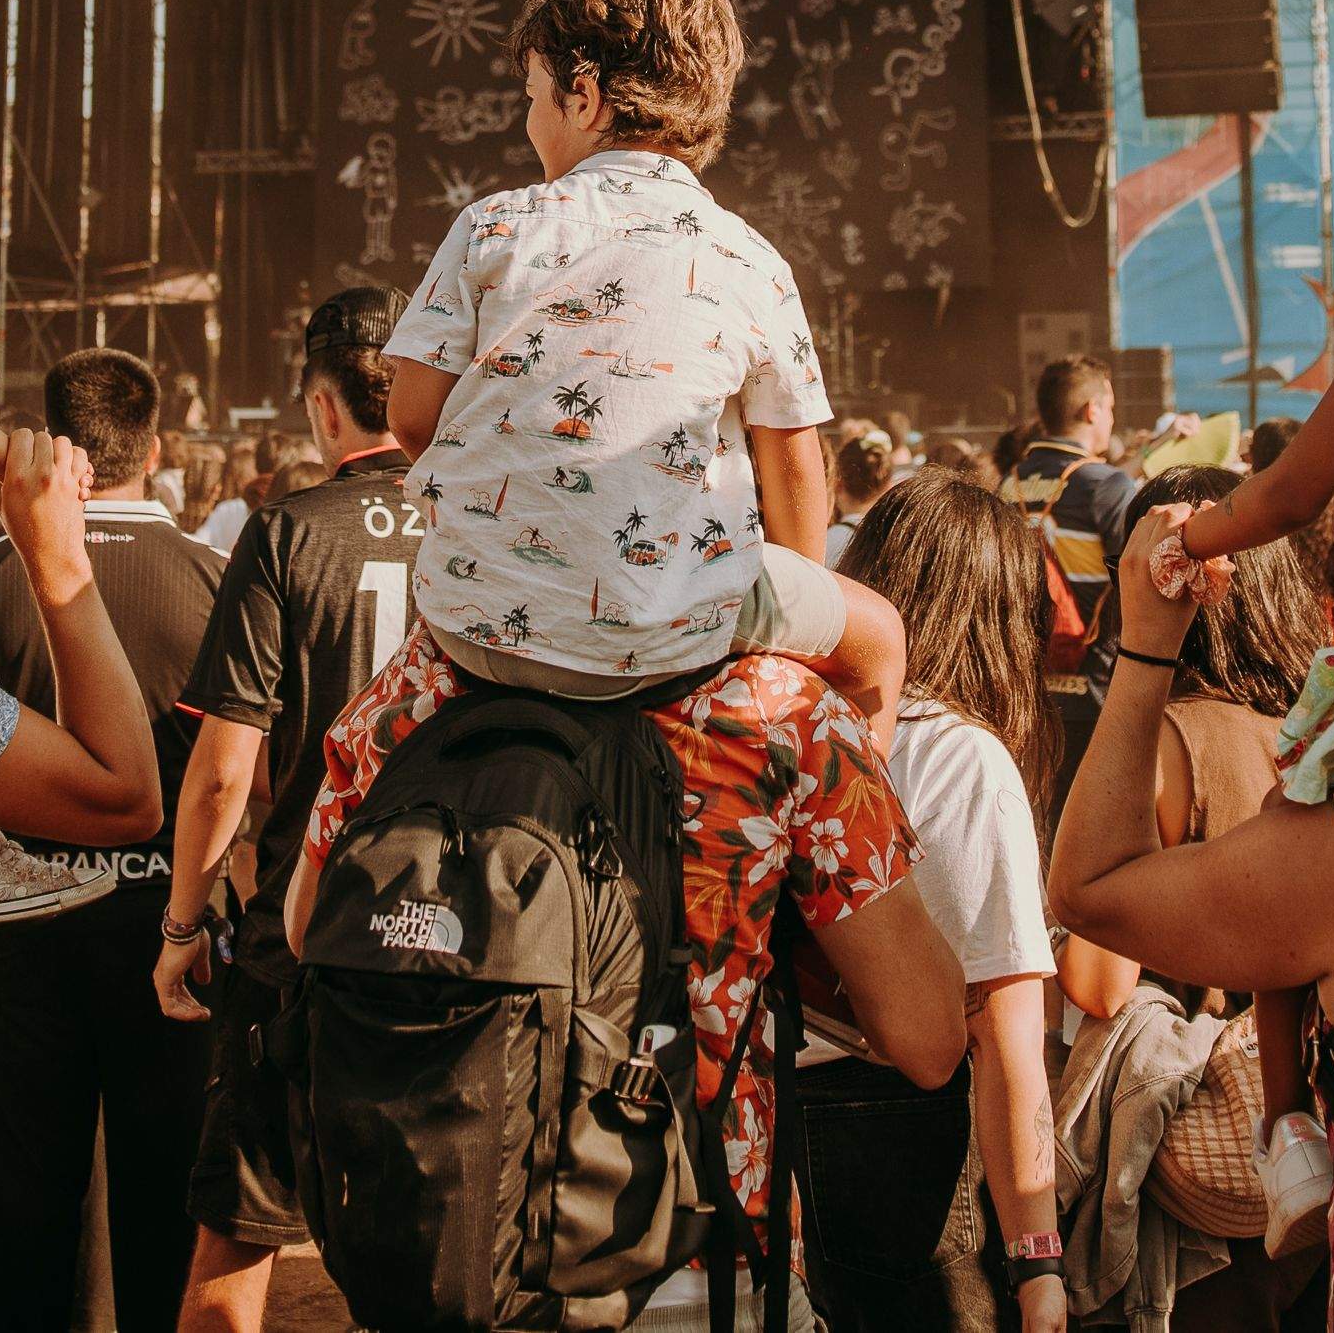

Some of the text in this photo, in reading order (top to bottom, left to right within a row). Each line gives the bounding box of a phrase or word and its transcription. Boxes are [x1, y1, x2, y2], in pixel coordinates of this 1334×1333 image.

[35, 851, 172, 880] ANCA
[400, 900, 438, 921] THE
[369, 914, 434, 939] NORTH
[382, 931, 428, 950] FACE
